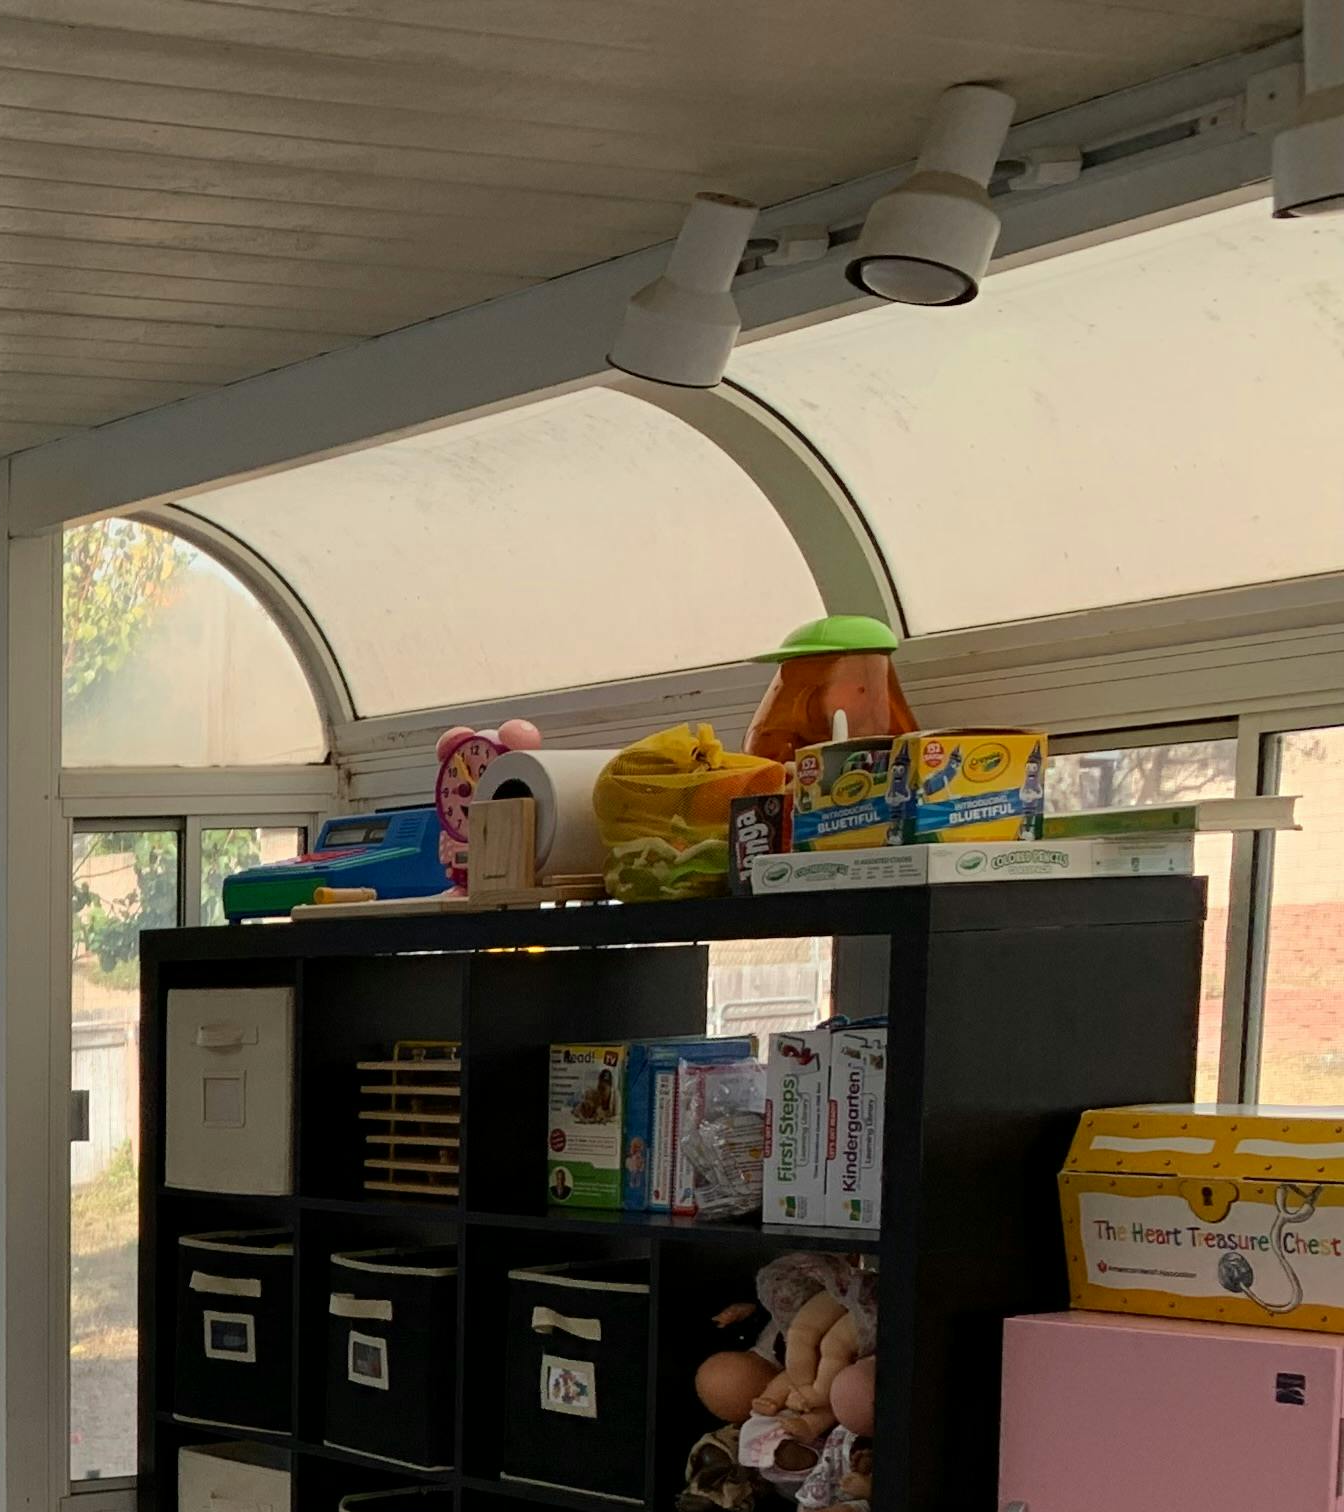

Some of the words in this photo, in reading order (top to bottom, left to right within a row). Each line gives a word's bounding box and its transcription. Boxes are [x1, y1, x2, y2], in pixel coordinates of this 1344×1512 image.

[470, 745, 480, 756] 12
[448, 767, 458, 778] 10
[949, 802, 1015, 825] BLUETIFUL
[954, 793, 1009, 811] INTRODUCING
[816, 810, 881, 834] BLUETIFUL
[779, 1078, 798, 1136] Steps
[842, 1071, 862, 1192] Kindergarten
[777, 1136, 795, 1182] First
[1094, 1220, 1128, 1241] The
[1132, 1223, 1182, 1246] Heart
[1187, 1227, 1271, 1252] Treasure
[1283, 1232, 1342, 1257] Chest
